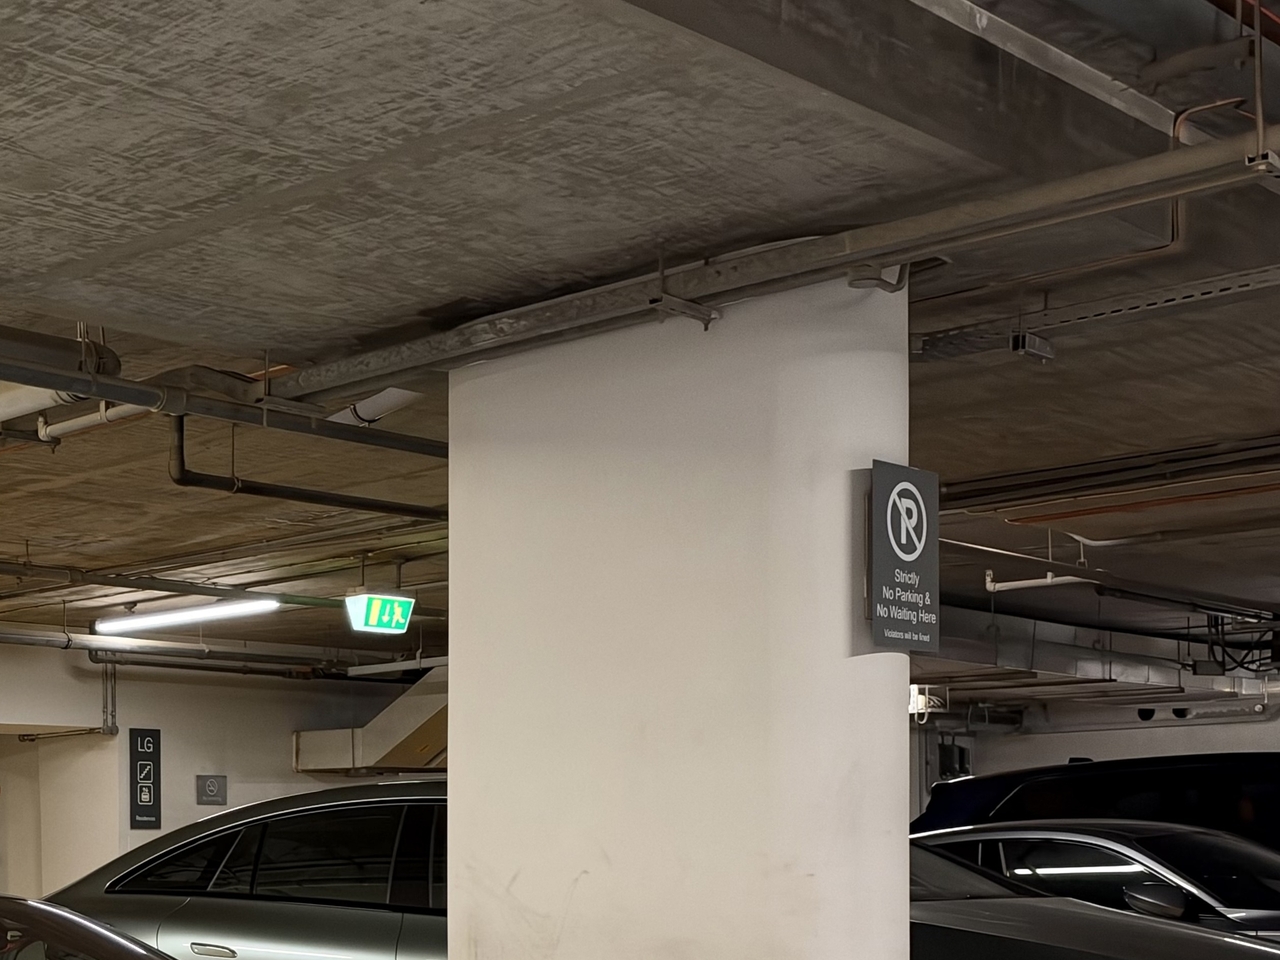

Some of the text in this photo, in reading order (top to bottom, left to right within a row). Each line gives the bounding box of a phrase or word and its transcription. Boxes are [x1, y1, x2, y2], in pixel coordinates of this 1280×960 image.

[894, 568, 920, 588] Strictly
[882, 585, 931, 607] No Parking &
[876, 603, 937, 625] No Waiting Here
[137, 737, 154, 752] LG
